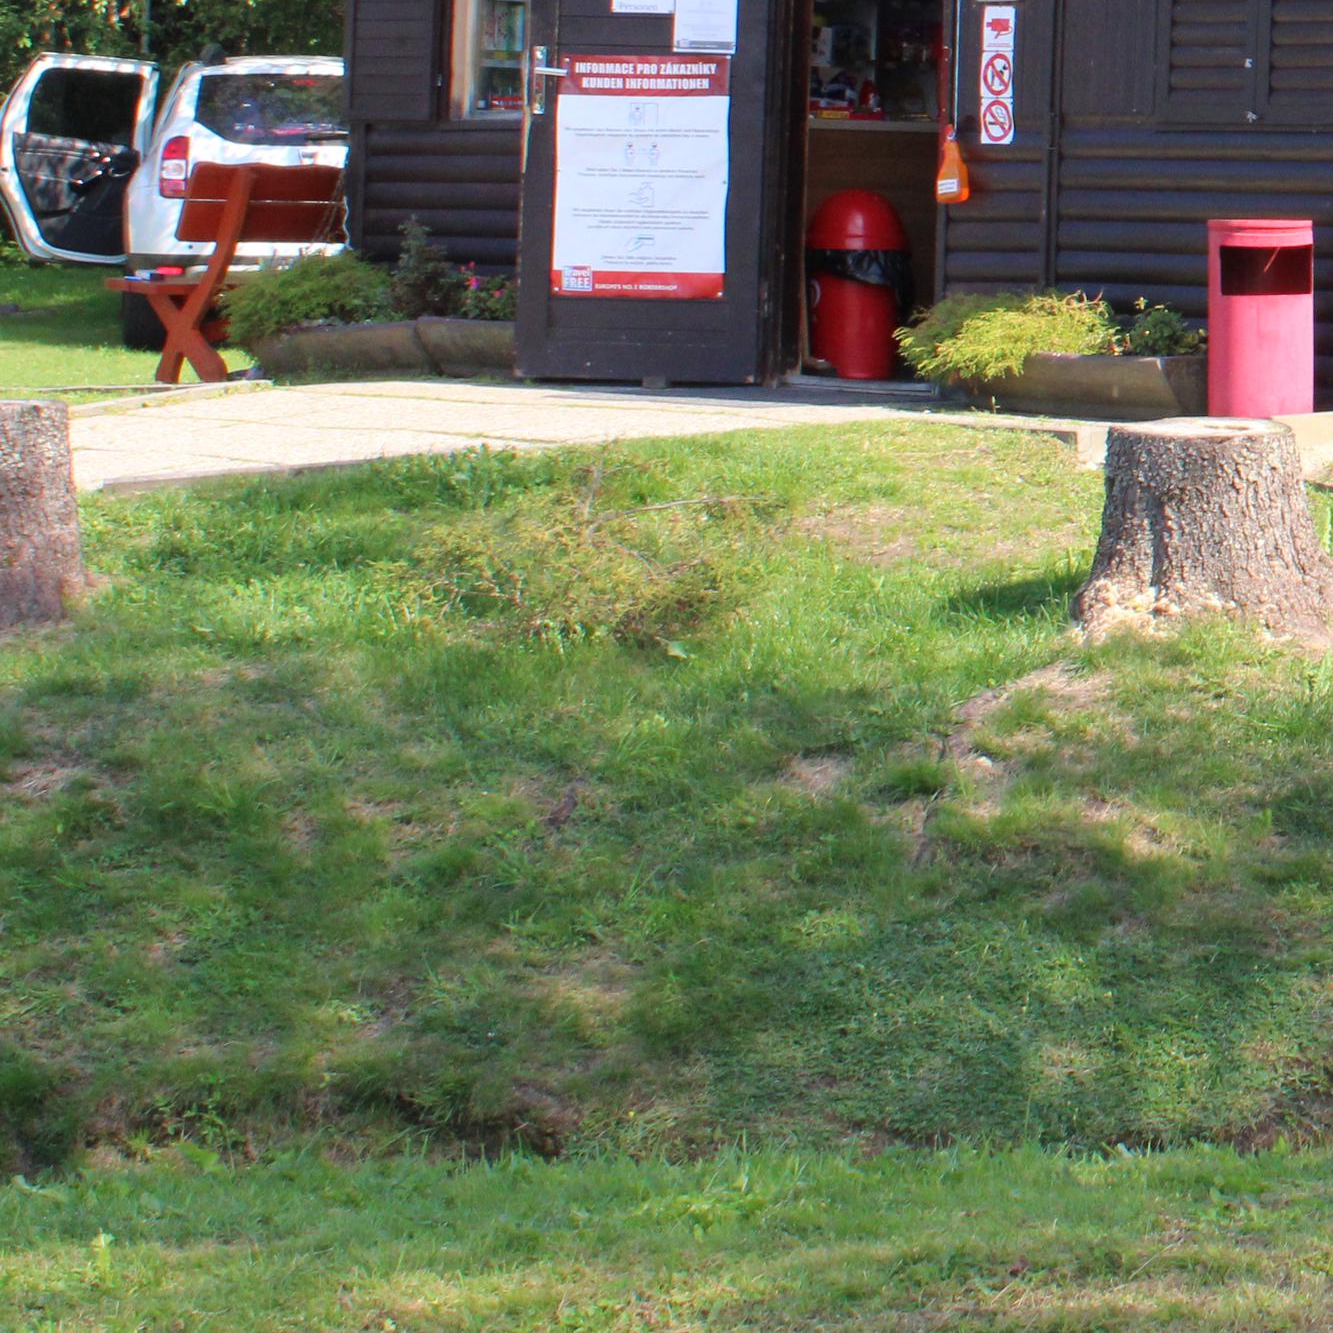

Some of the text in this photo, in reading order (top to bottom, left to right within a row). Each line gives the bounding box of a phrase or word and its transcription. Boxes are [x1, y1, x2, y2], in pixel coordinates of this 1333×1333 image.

[575, 62, 635, 74] INFORMACE
[636, 63, 658, 75] PRO
[582, 77, 709, 90] KUNDEN INFORMATIONEN
